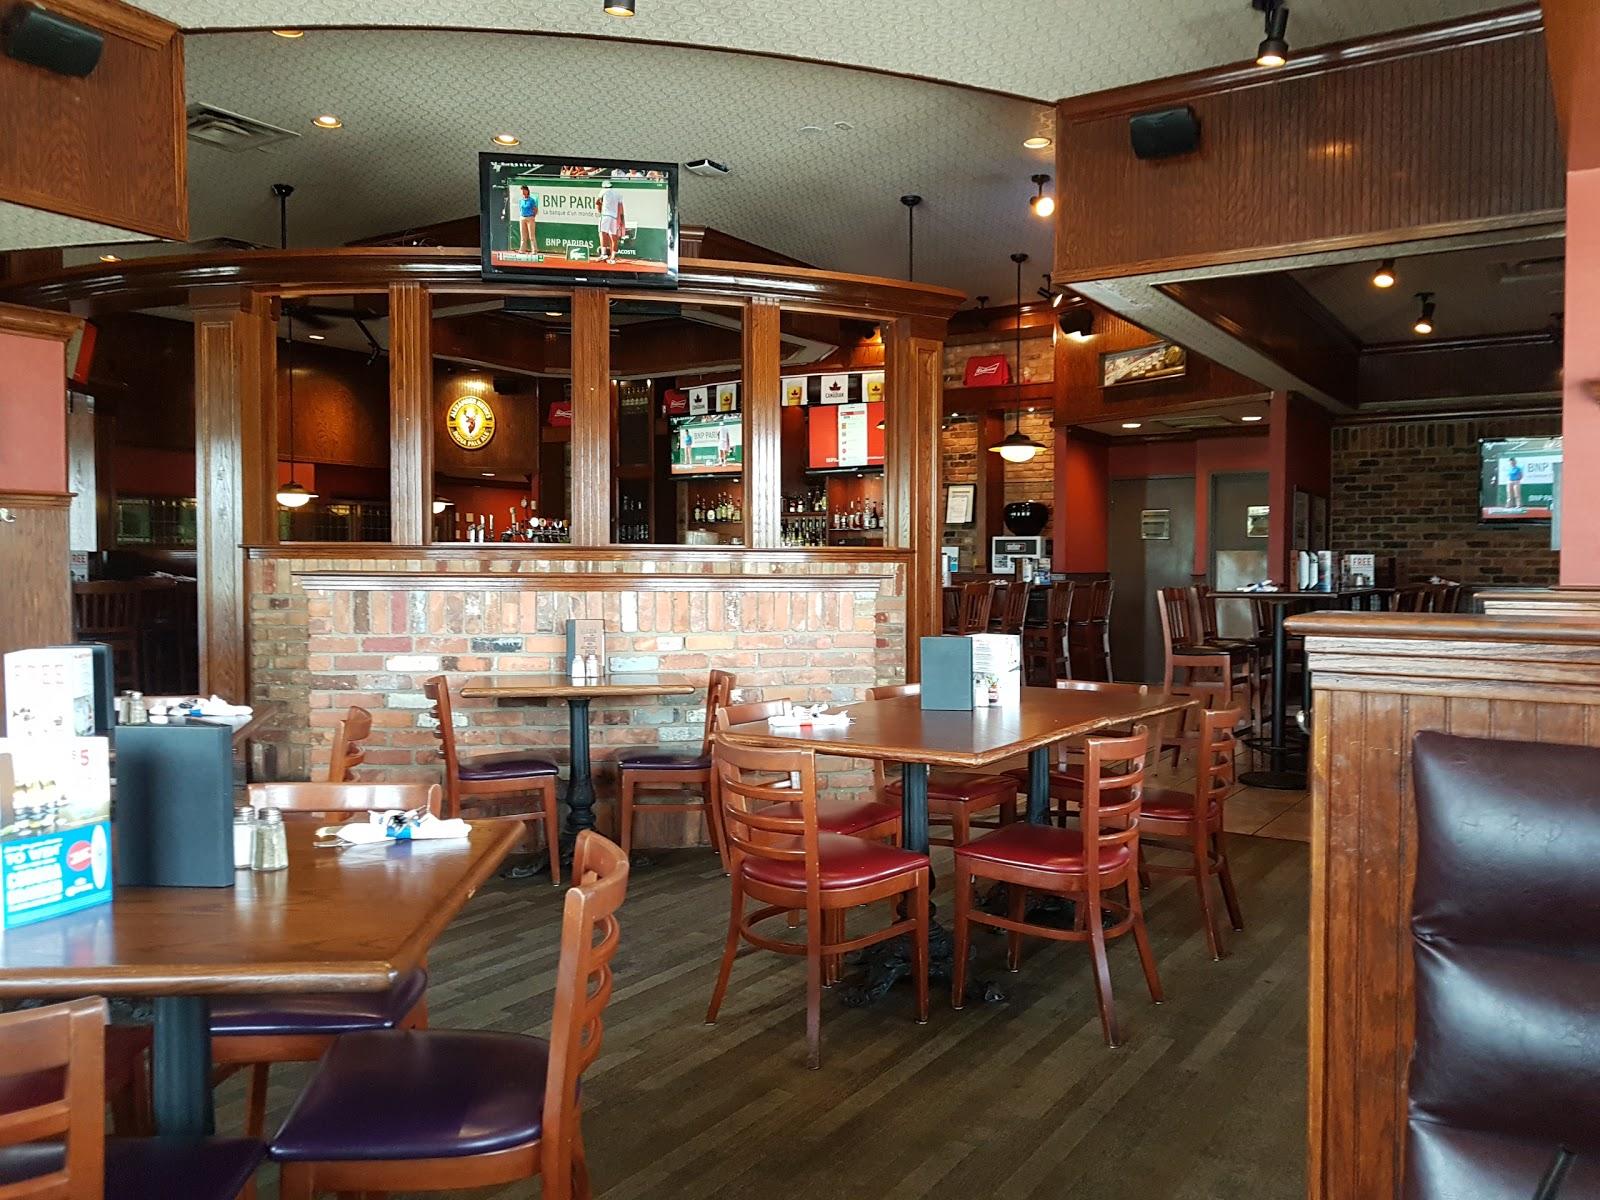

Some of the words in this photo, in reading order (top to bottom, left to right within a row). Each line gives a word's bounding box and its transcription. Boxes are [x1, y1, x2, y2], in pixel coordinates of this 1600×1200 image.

[543, 195, 566, 208] BNP
[545, 238, 561, 247] BNP
[562, 239, 594, 249] PARIBAS
[452, 430, 467, 446] INDIA
[480, 430, 490, 442] ALE
[1528, 462, 1548, 473] BNP
